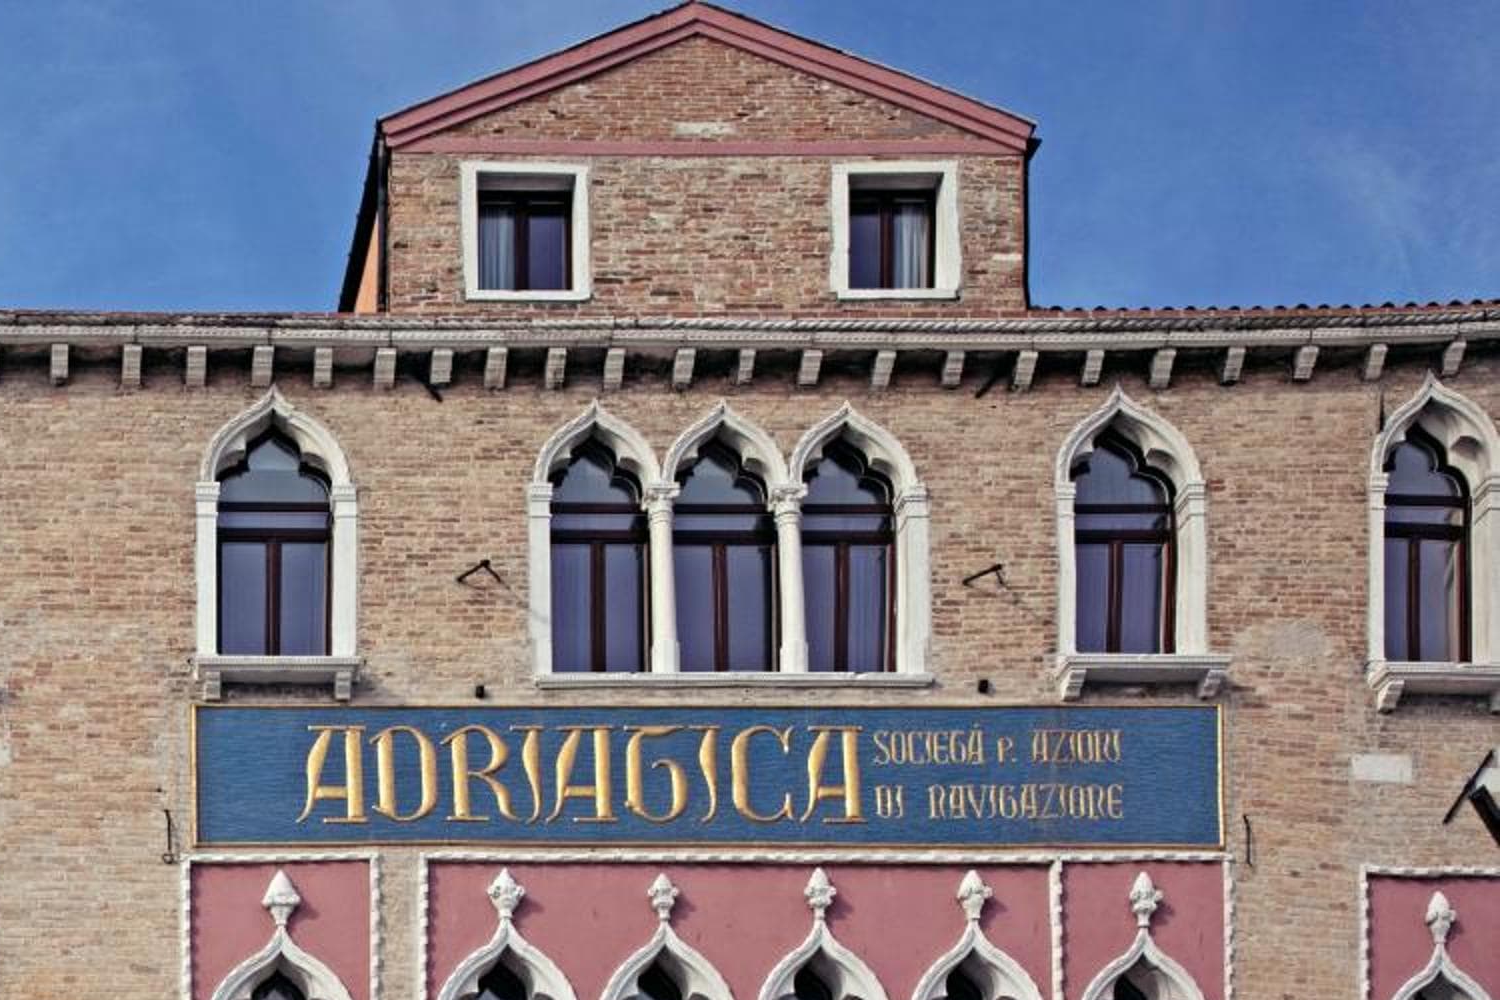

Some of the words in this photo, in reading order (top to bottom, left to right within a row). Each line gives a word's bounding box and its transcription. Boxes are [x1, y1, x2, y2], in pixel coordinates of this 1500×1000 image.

[1032, 729, 1122, 764] AZIONI
[296, 725, 866, 823] ADRIATICA
[875, 784, 905, 819] DI
[928, 784, 1124, 820] NAVIGAZIONE
